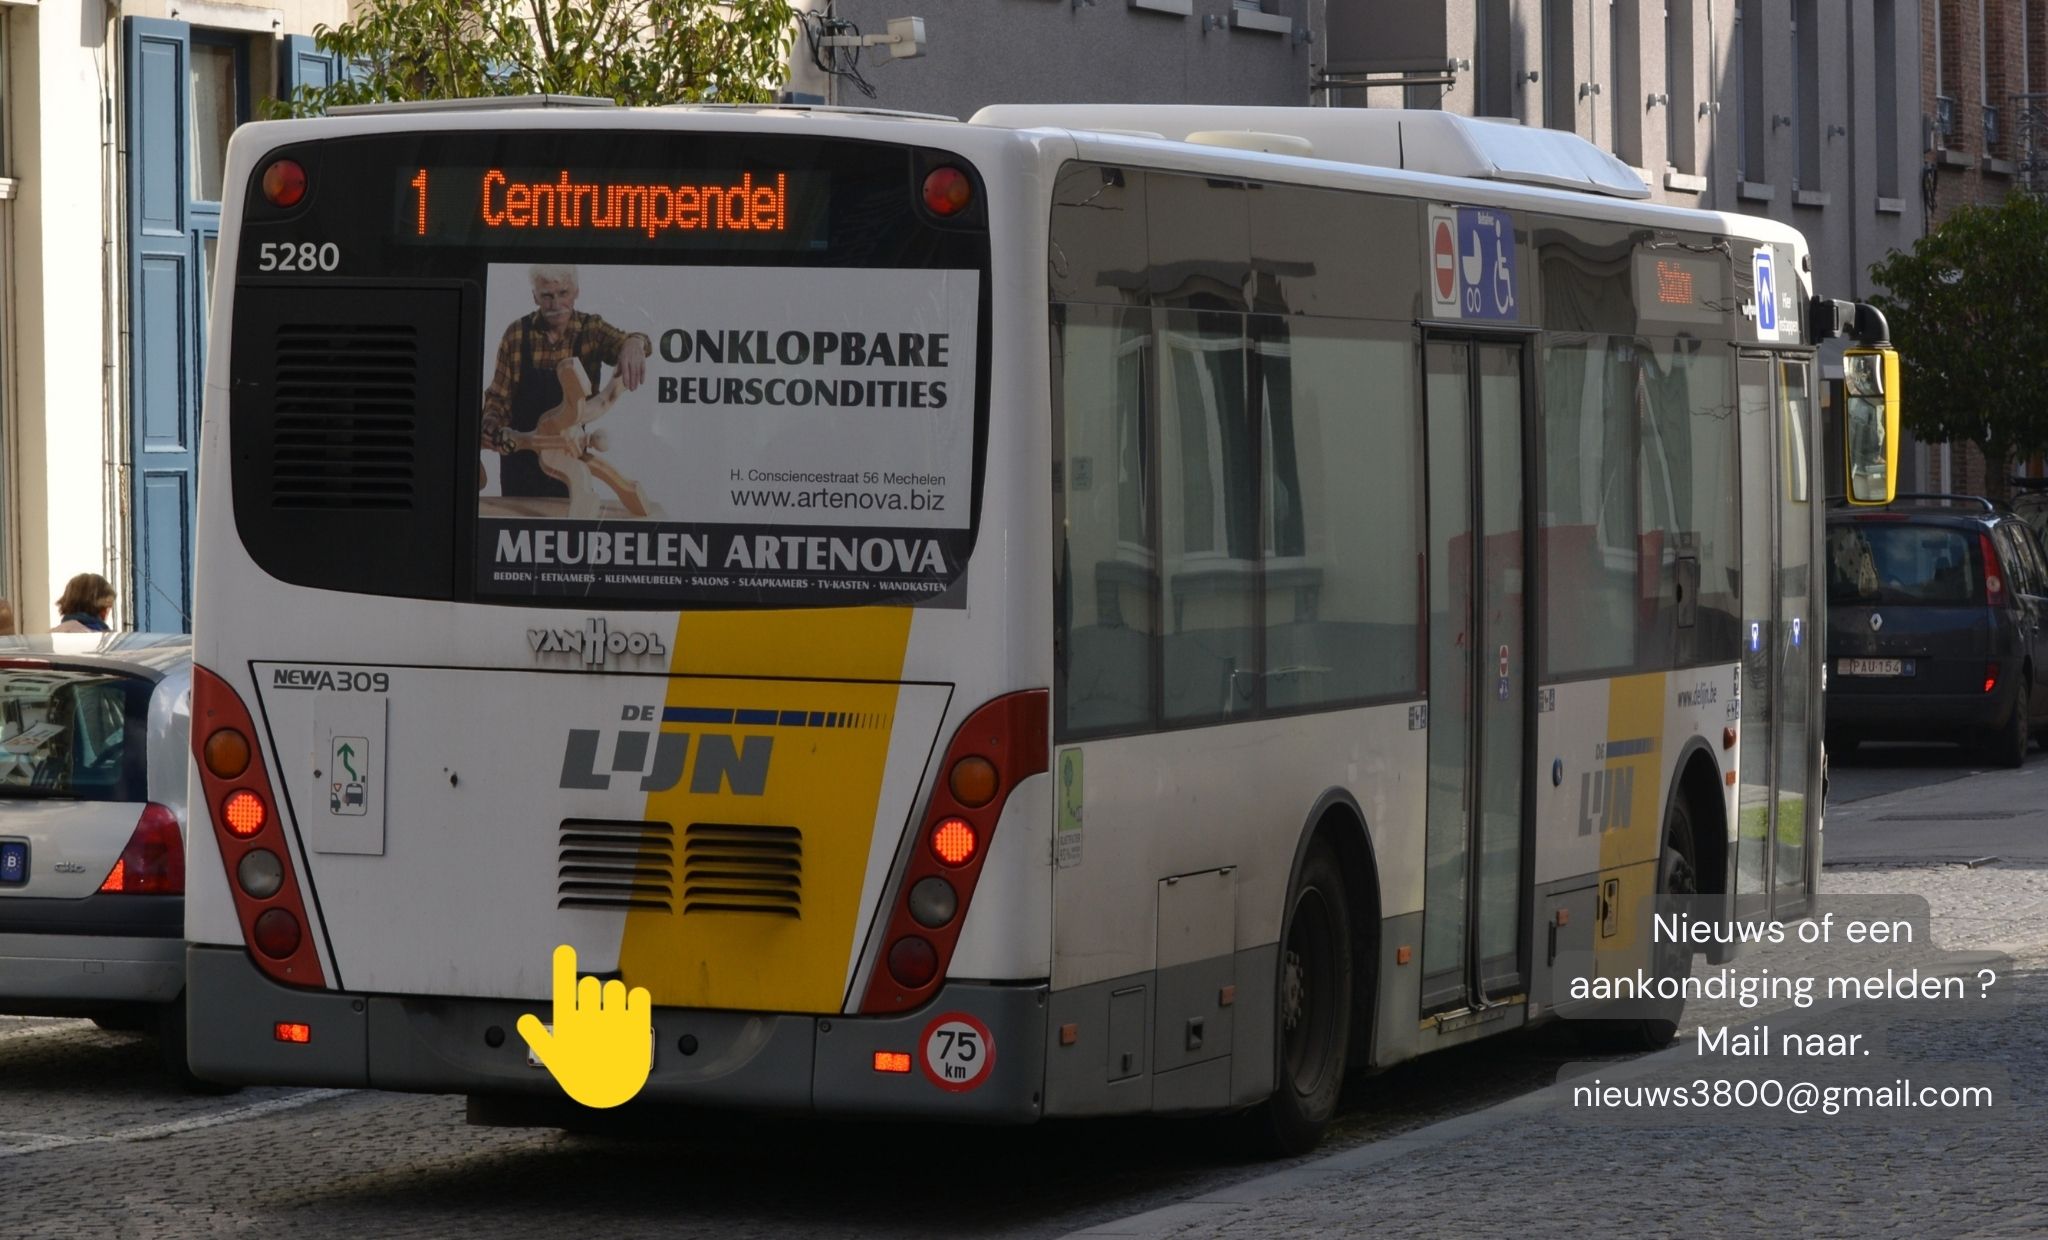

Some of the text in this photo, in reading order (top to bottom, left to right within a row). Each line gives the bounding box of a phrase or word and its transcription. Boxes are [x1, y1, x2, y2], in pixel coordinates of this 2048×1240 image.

[411, 169, 786, 239] 1 Centrumpendel
[258, 242, 340, 272] 5280
[659, 328, 949, 367] ONKLOPBARE
[658, 376, 948, 409] BEURSCONDITIES
[730, 468, 946, 486] H. Consciencestraat 56 Mechelen
[731, 487, 945, 511] www.artenova.biz
[494, 529, 948, 574] MEUBELEN ARTENOVA
[493, 571, 947, 592] BEDDEN EETKAMERS KLEINMEUBELEN SALONS SLAAPKAMERS TV-KASTEN WANDKASTEN
[1678, 680, 1717, 710] www.delijn.be
[621, 704, 656, 721] DE
[559, 728, 775, 796] LIJN
[1595, 742, 1606, 760] DE
[1578, 764, 1635, 837] LIJN
[7, 855, 17, 868] B
[936, 1030, 977, 1063] 75
[944, 1061, 967, 1079] km
